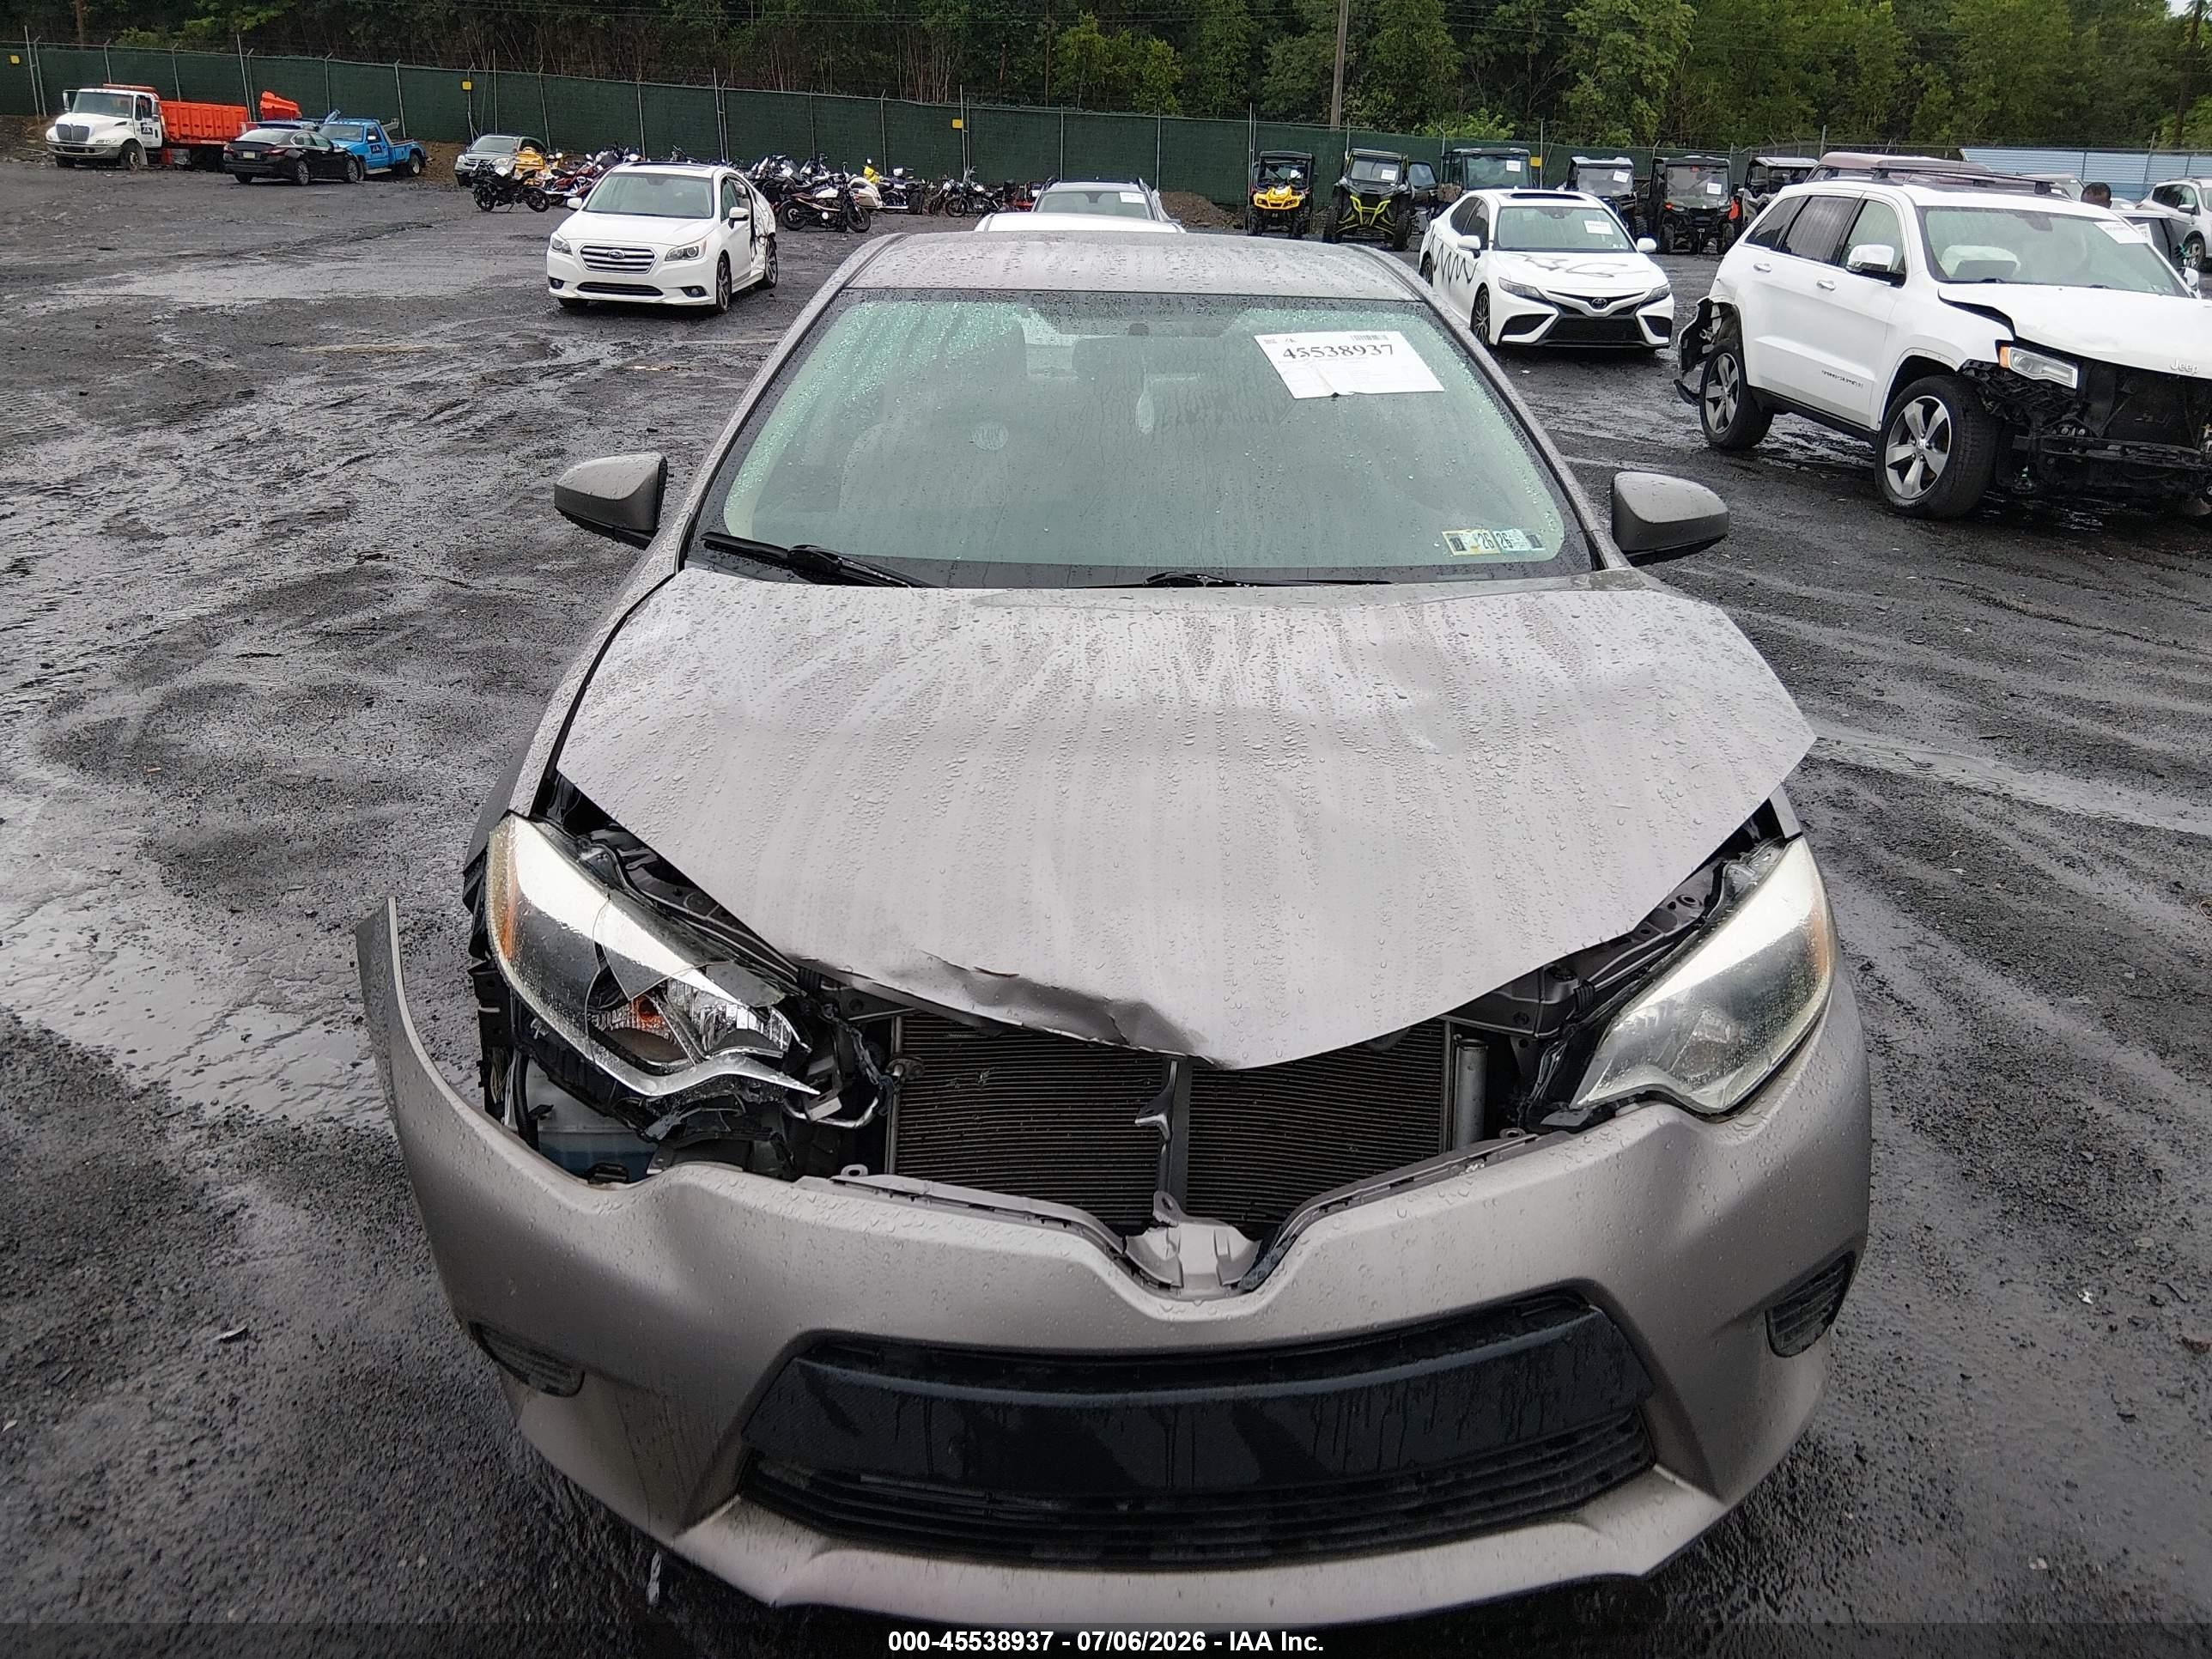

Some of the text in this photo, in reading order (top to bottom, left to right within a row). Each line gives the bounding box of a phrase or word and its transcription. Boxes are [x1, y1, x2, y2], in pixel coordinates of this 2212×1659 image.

[1282, 343, 1394, 359] 45538937
[2170, 357, 2199, 375] Jeep
[1478, 532, 1495, 550] 26
[1496, 532, 1514, 549] 26
